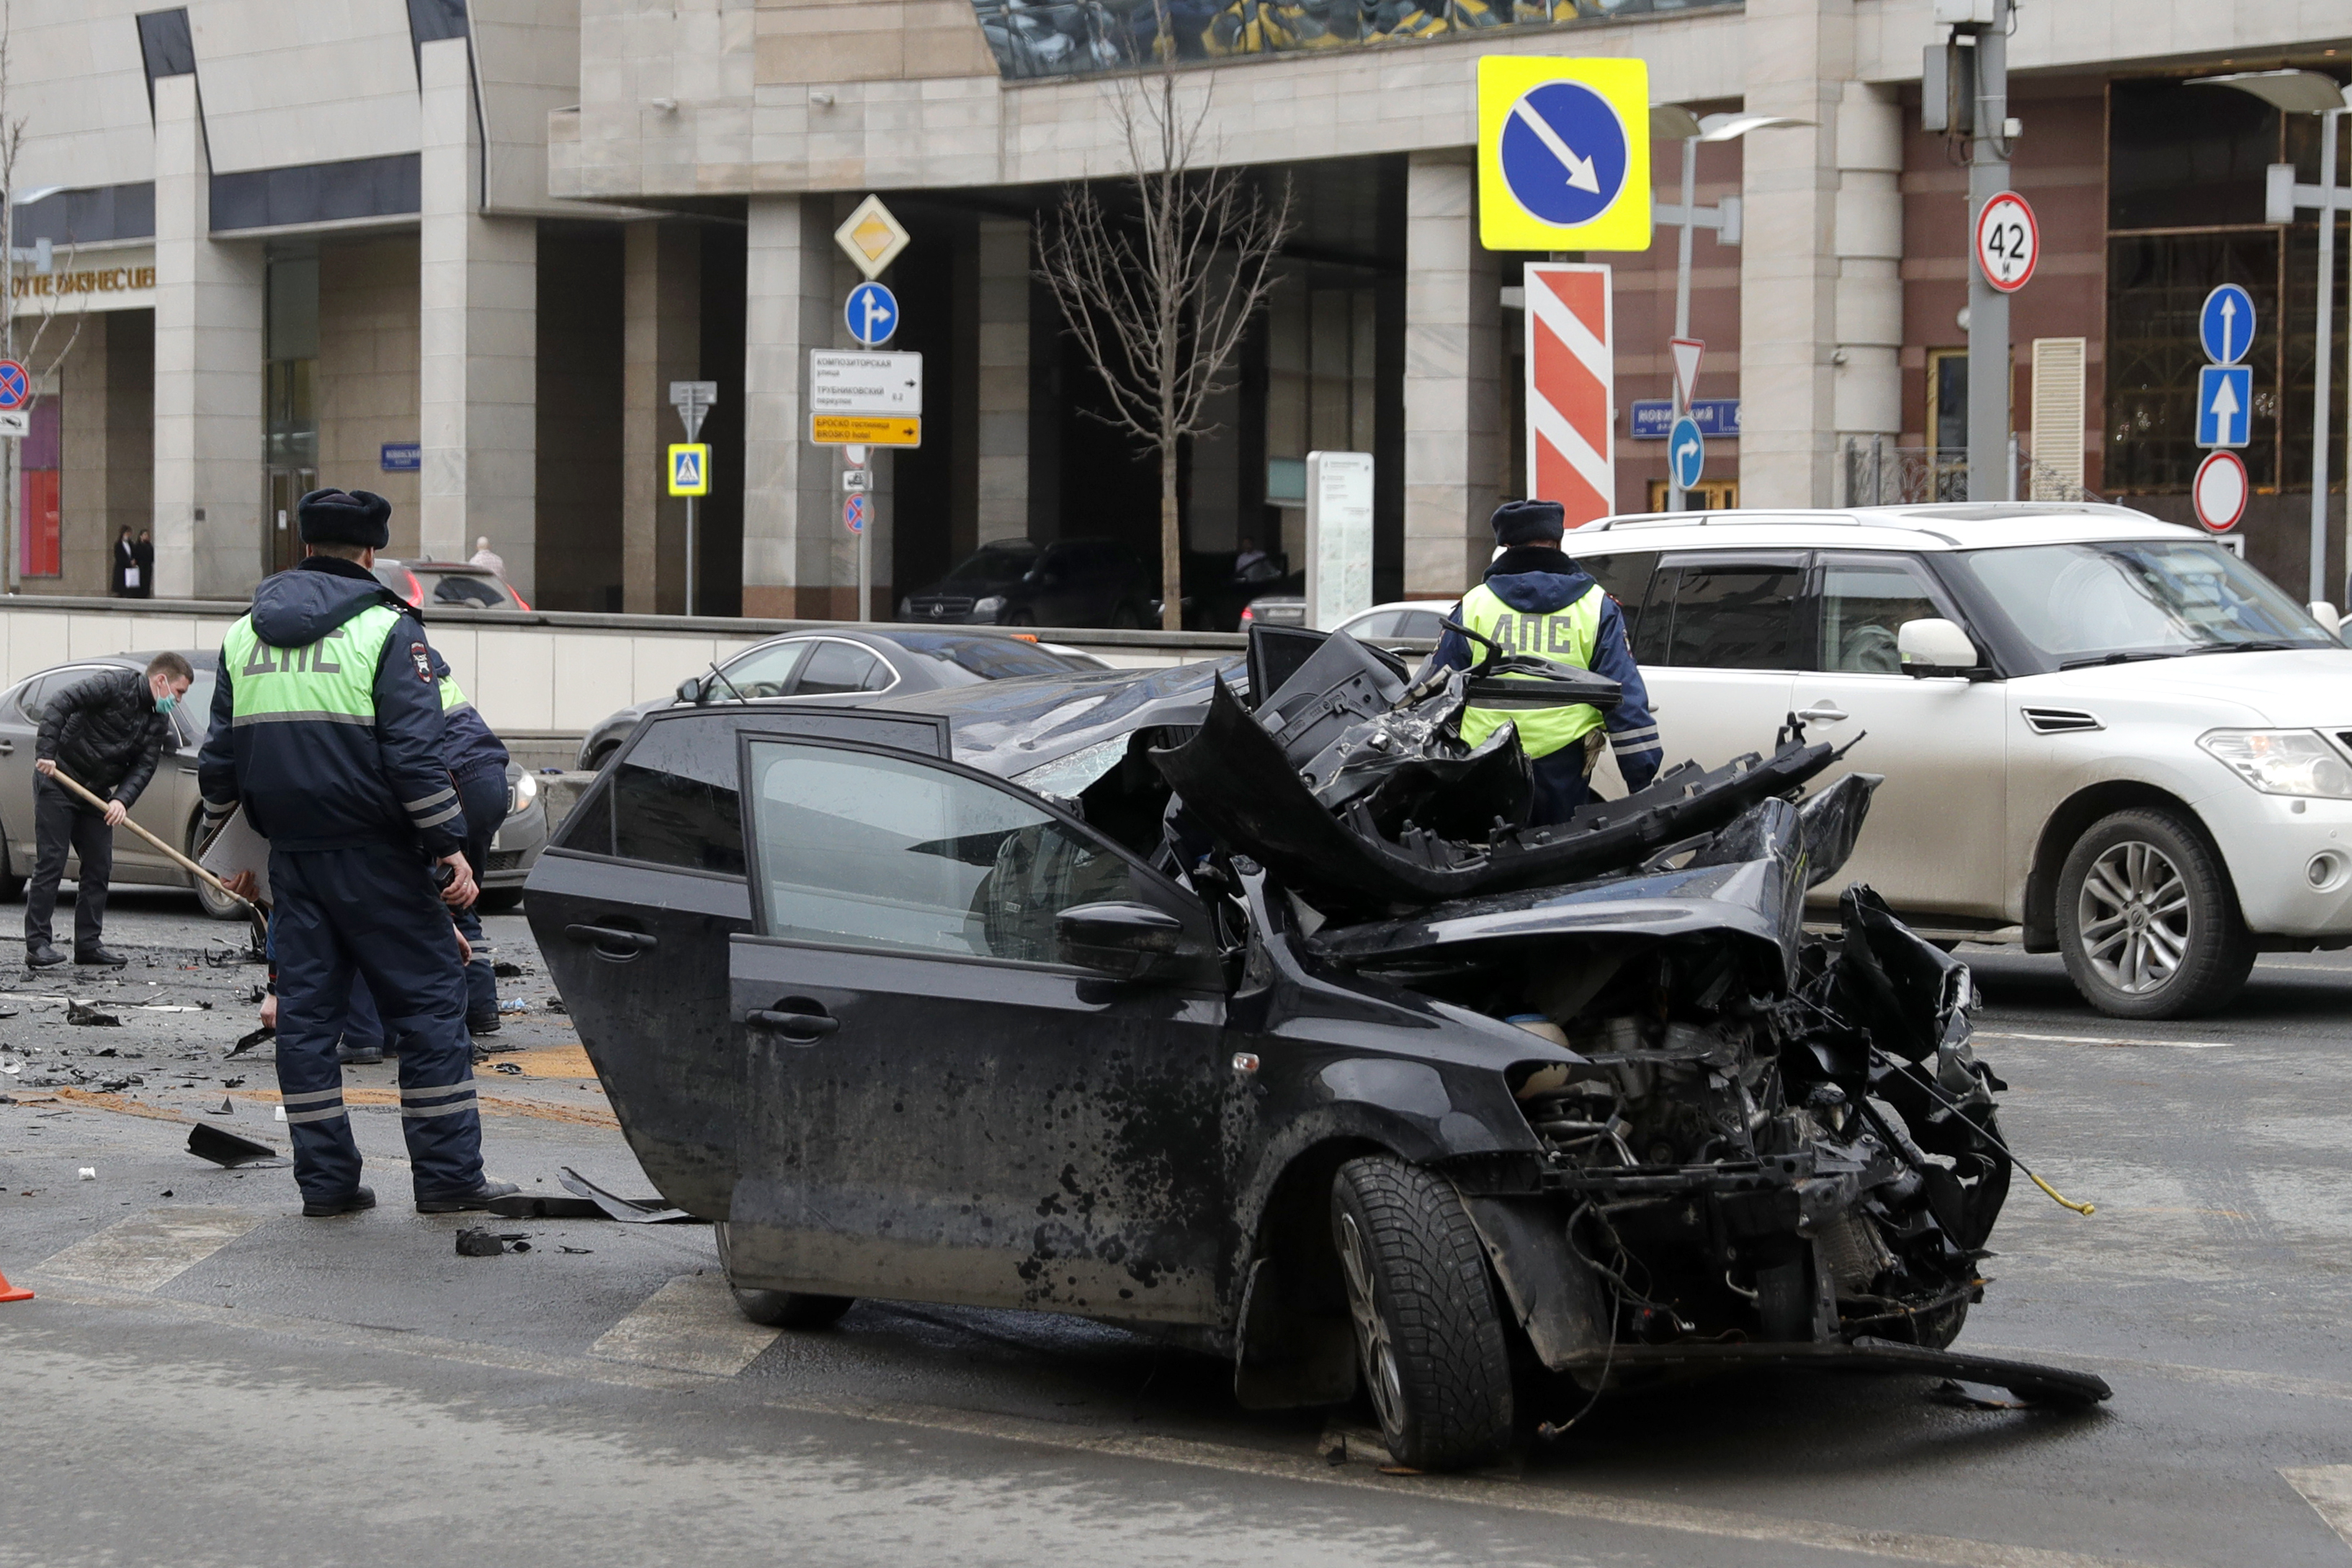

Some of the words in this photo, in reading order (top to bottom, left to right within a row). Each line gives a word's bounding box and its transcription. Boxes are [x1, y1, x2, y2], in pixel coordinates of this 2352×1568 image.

[1988, 223, 2024, 259] 42
[12, 274, 53, 297] ОТТЕ
[817, 358, 892, 367] КОМПОЗИТОРСКАЯ
[817, 385, 884, 395] ТРУБНИКОВСКИЙ
[816, 418, 849, 427] БРОСКО
[816, 429, 850, 439] BROSKO
[1490, 613, 1571, 656] ДПС
[242, 629, 346, 677] ДПС
